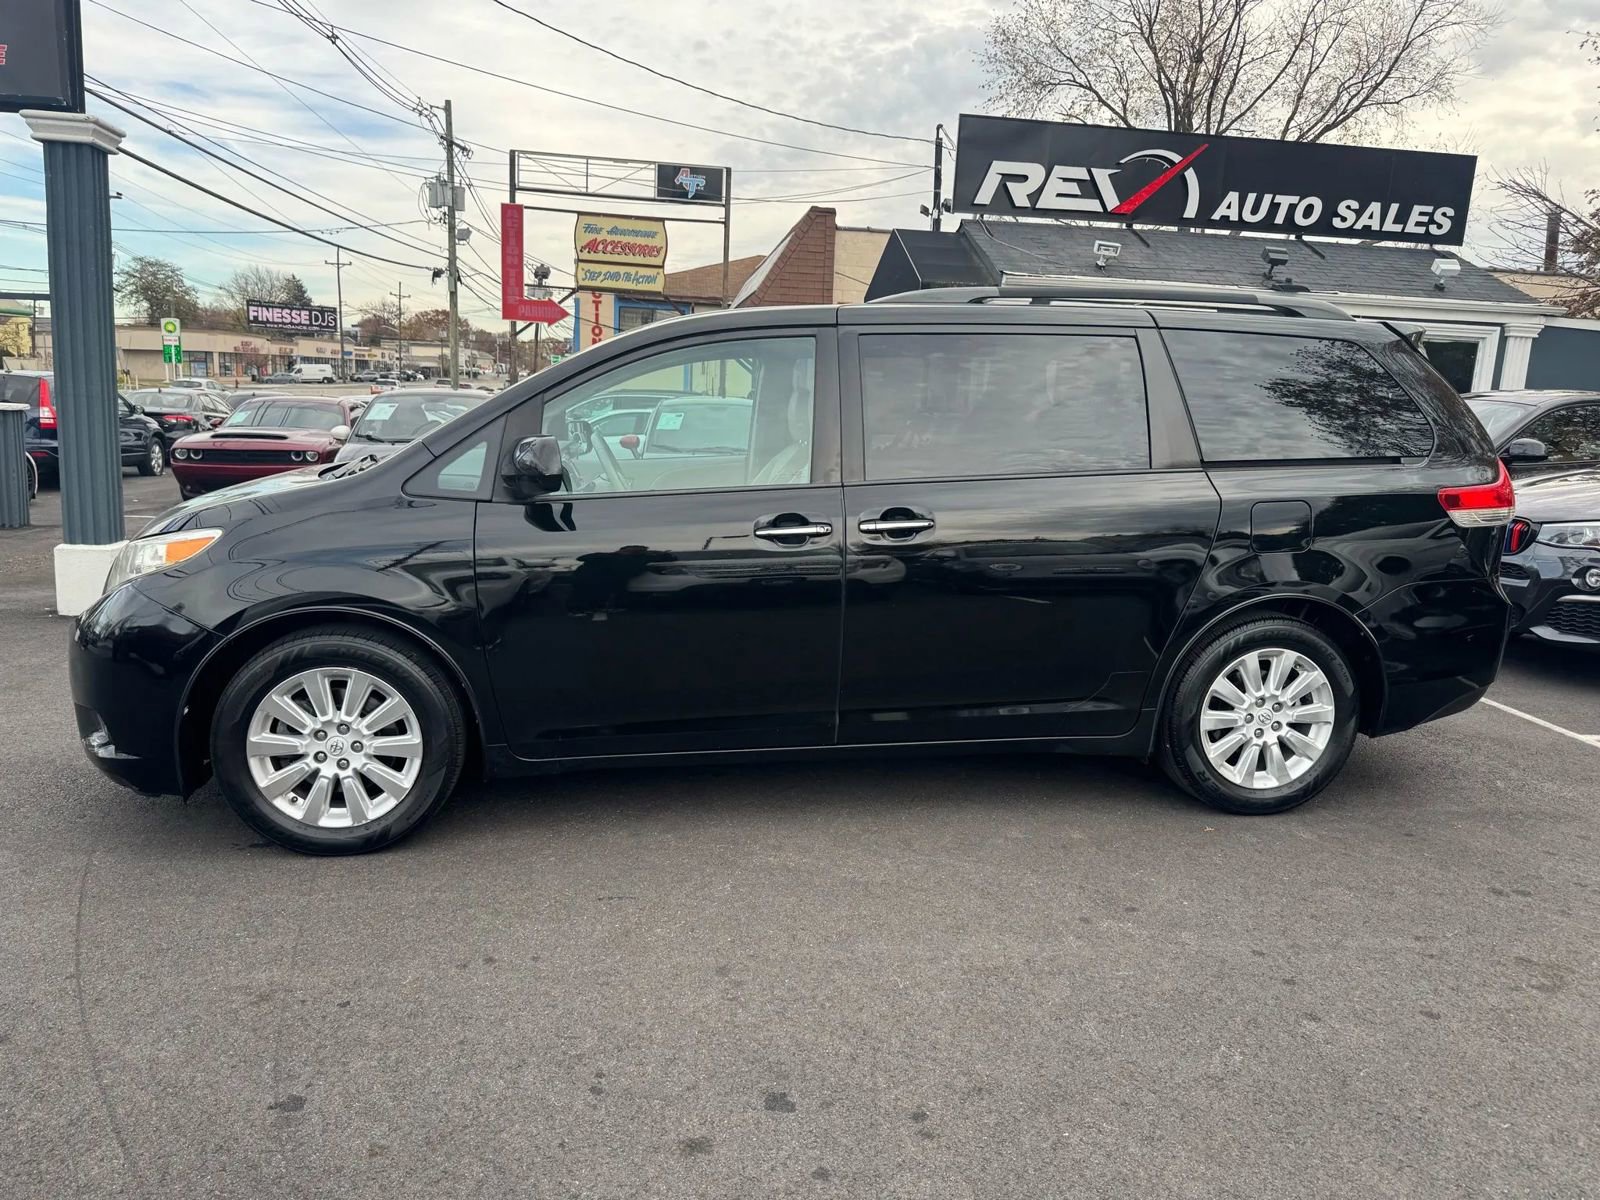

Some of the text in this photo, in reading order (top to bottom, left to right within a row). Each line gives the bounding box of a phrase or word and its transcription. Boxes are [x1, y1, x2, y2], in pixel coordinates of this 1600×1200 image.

[973, 144, 1455, 235] REV AUTO SALES
[580, 237, 663, 258] ACCESSORIES
[248, 306, 310, 325] FINESSE
[518, 305, 562, 319] PARKING
